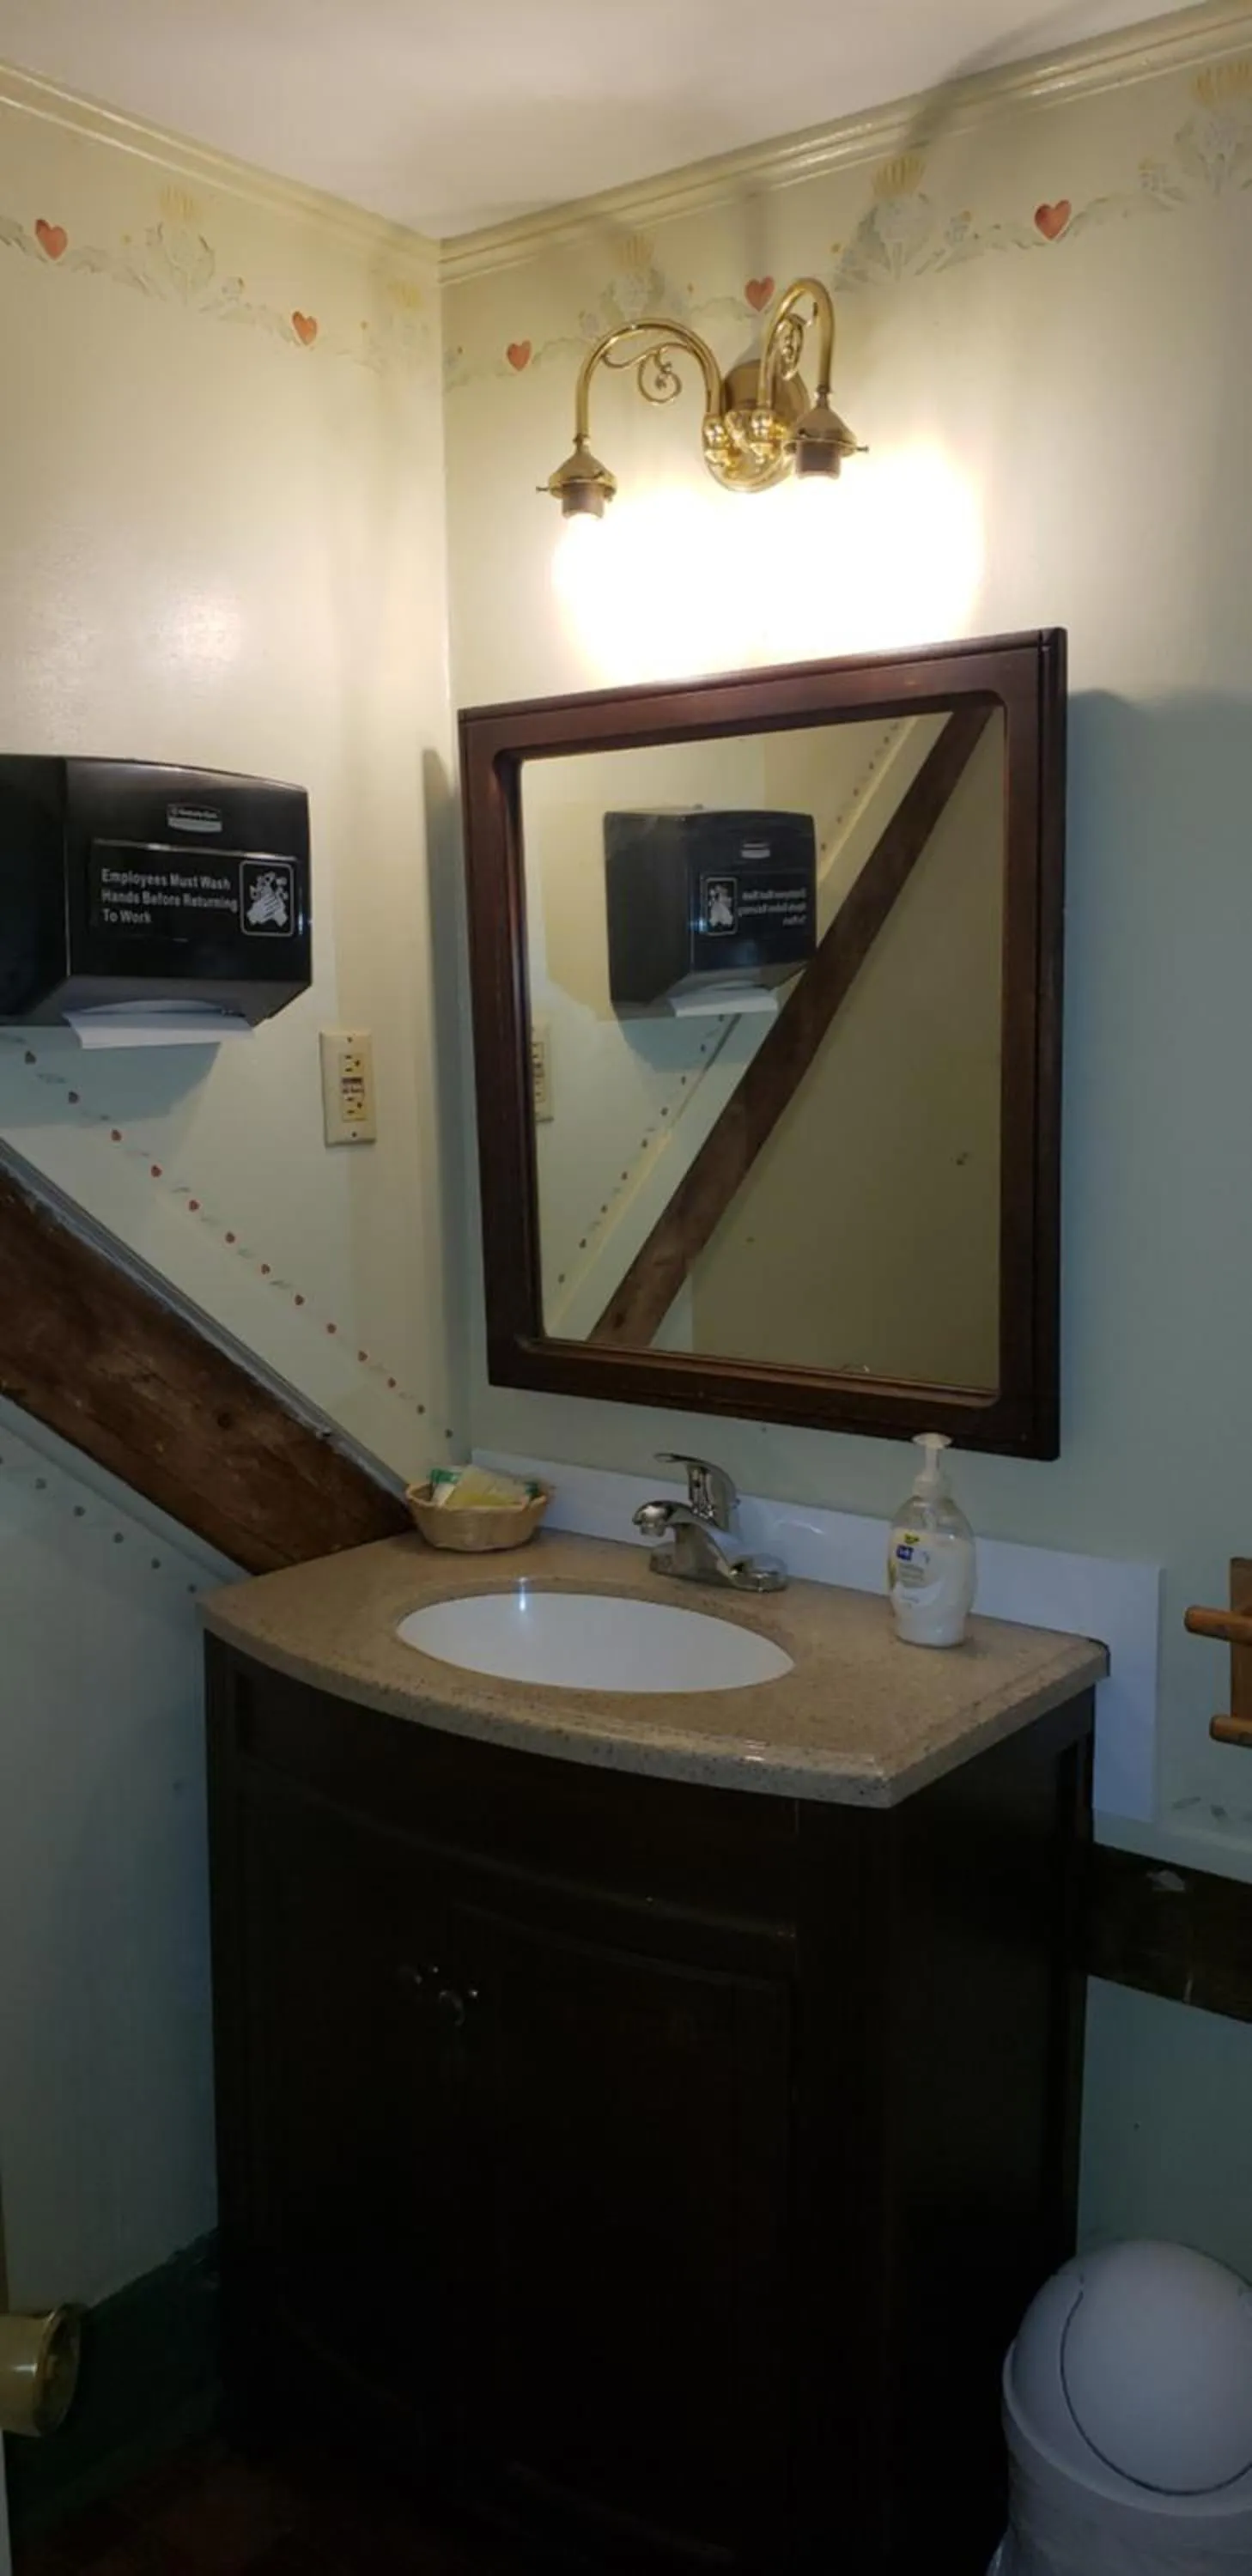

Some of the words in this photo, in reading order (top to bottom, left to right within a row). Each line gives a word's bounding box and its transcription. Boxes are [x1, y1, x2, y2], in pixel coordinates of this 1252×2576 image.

[101, 868, 167, 888] Employees
[171, 873, 198, 888] Must
[201, 876, 231, 890] Wash
[101, 890, 139, 904] Hands
[143, 892, 180, 907] Before
[183, 894, 238, 913] Returning
[103, 909, 119, 922] To
[119, 910, 151, 924] Work
